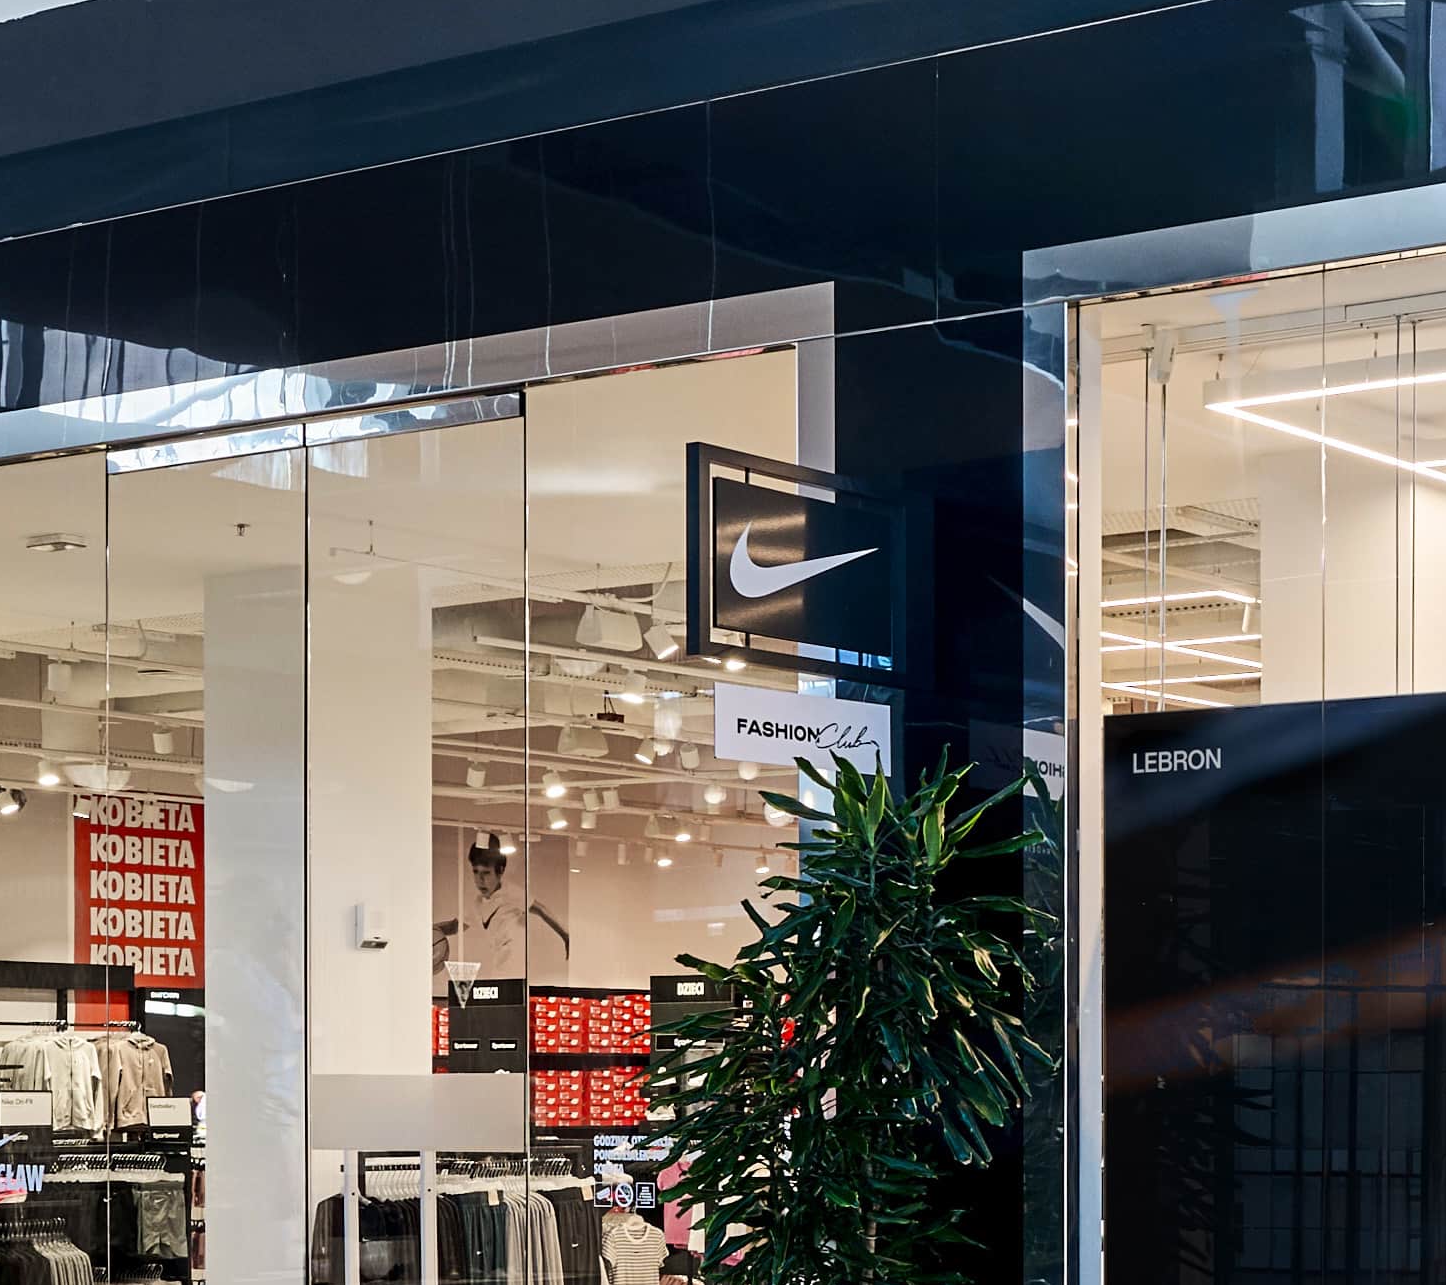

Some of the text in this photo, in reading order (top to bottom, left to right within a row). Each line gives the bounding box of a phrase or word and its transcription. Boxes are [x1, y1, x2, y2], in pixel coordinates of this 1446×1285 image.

[737, 718, 820, 743] FASHION
[1132, 748, 1222, 774] LEBRON
[90, 833, 196, 869] KOBIETA
[90, 870, 196, 905] KOBIETA
[90, 907, 196, 941] KOBIETA
[90, 944, 196, 976] KOBIETA
